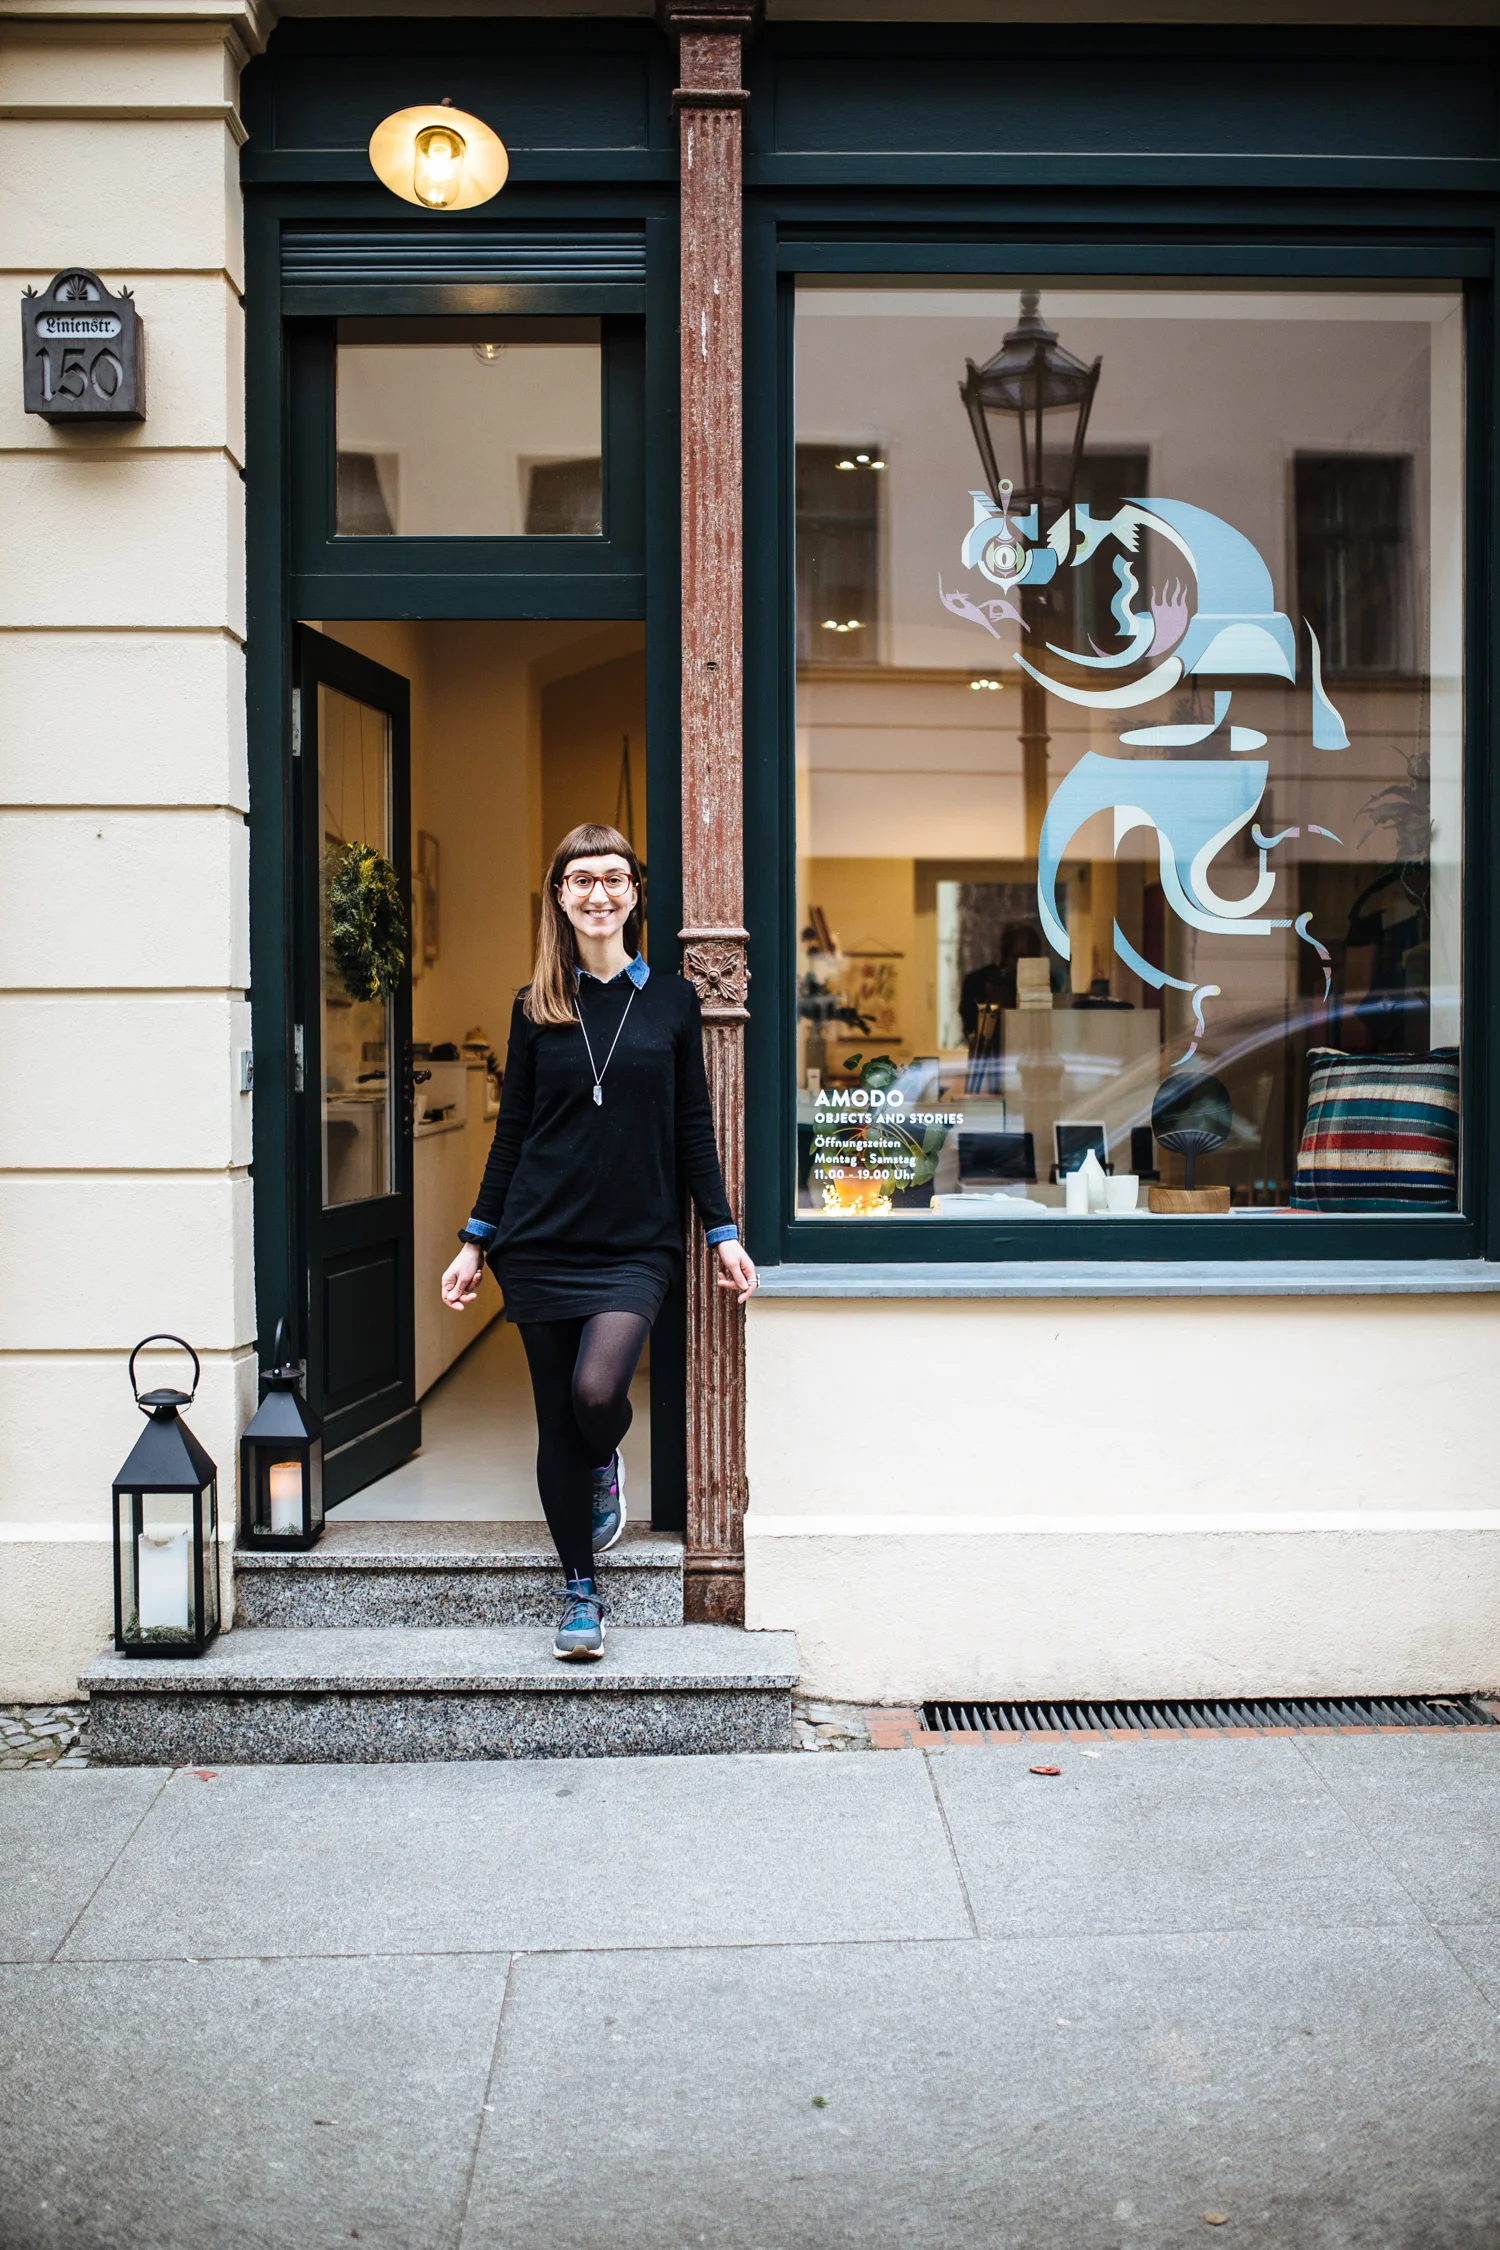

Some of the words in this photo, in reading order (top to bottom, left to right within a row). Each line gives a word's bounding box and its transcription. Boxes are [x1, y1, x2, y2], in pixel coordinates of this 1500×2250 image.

[46, 317, 115, 333] Linienstr.
[35, 347, 123, 401] 150
[814, 1089, 904, 1107] AMODO
[814, 1112, 872, 1124] OBJECTS
[876, 1112, 905, 1124] AND
[909, 1112, 964, 1124] STORIES
[814, 1134, 901, 1151] Öffnungszeiten
[814, 1153, 857, 1167] Montag
[869, 1153, 916, 1167] Samstag
[814, 1169, 845, 1180] 11.00
[857, 1169, 890, 1180] 19.00
[894, 1169, 916, 1180] Uhr
